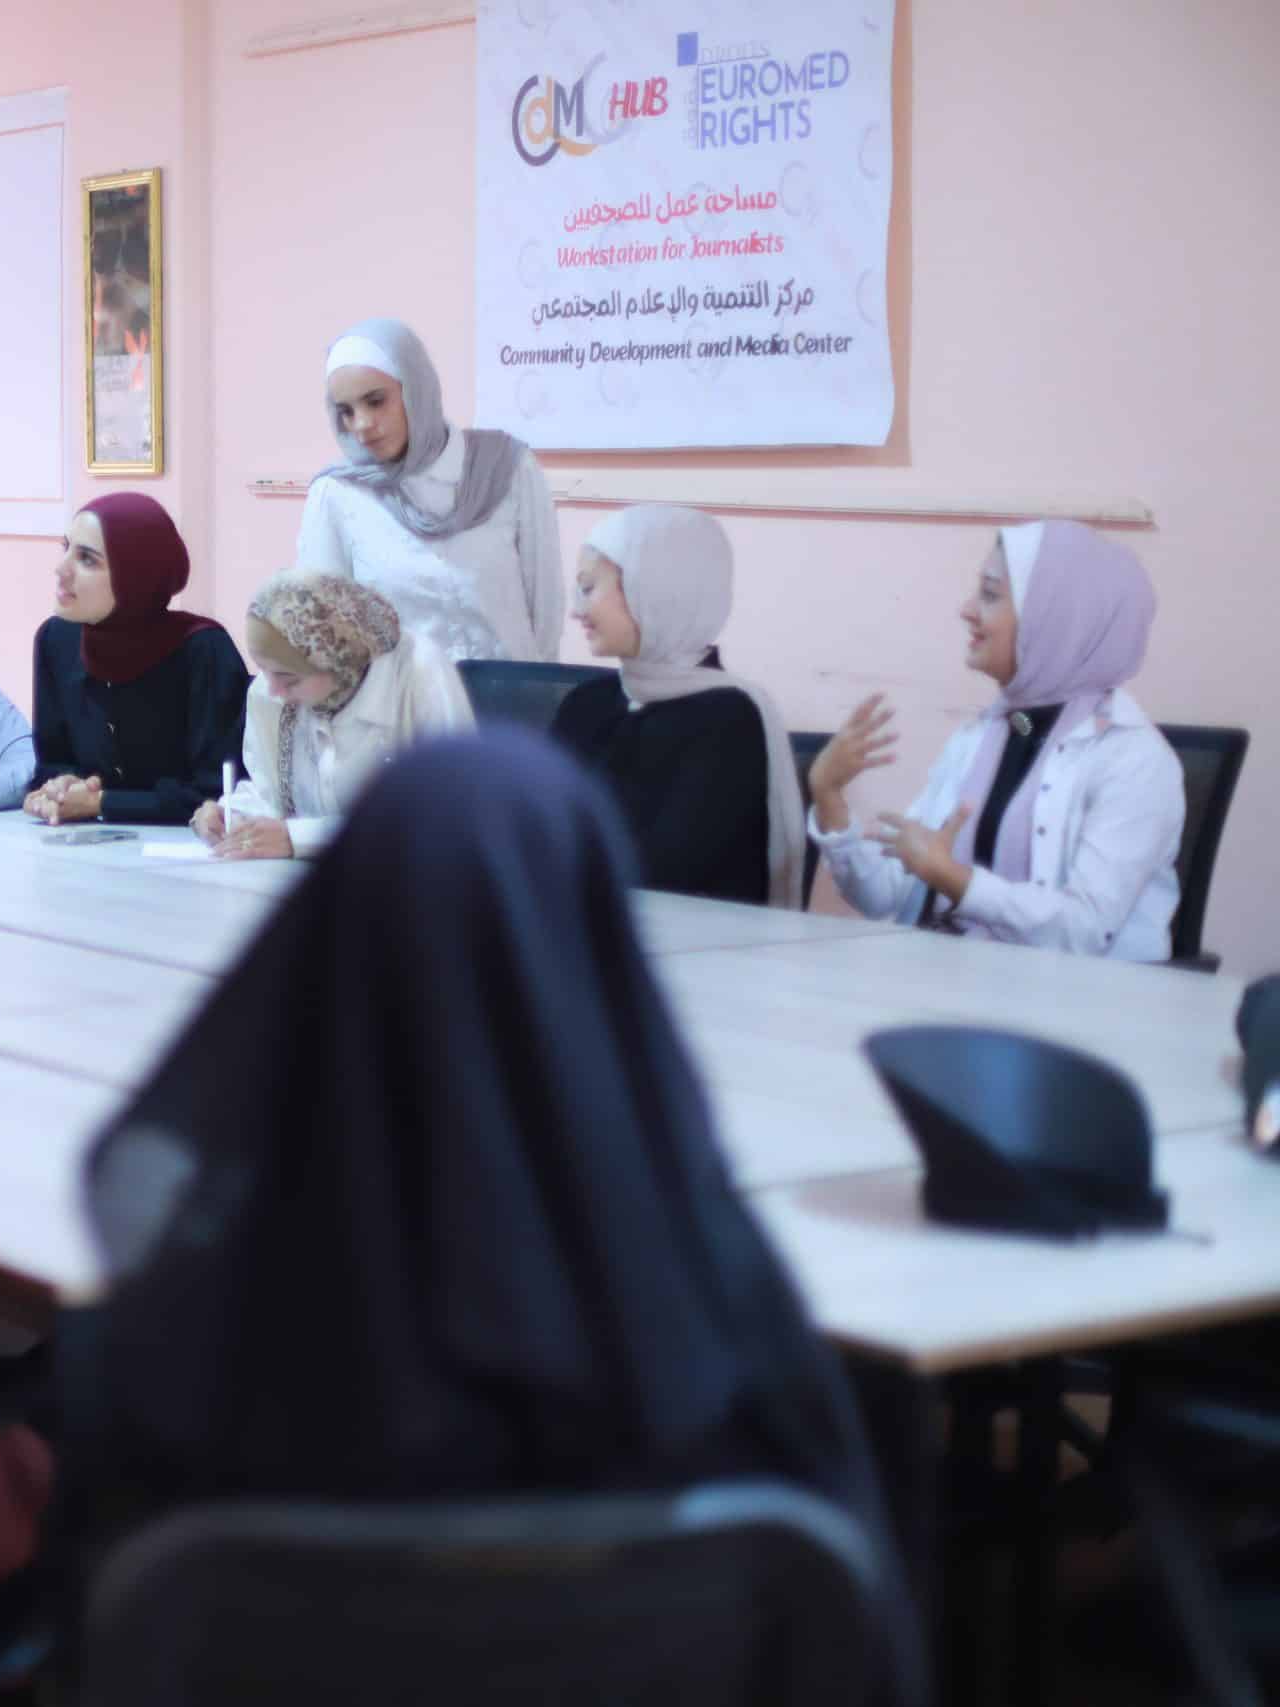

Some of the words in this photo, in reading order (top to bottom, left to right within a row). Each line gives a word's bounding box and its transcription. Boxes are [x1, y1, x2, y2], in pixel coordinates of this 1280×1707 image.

[699, 51, 851, 104] EUROMED
[608, 76, 668, 120] HUB
[699, 101, 811, 150] RIGHTS
[564, 192, 651, 232] للصحفيين
[656, 191, 698, 224] عمل
[706, 184, 777, 214] مساحة
[557, 241, 657, 269] Workstation
[662, 237, 683, 262] for
[689, 231, 785, 259] Journalists
[532, 290, 622, 331] المجتمعي
[703, 280, 770, 317] التنمية
[773, 277, 814, 317] مركز
[500, 341, 586, 370] Community
[589, 338, 691, 366] Development
[697, 335, 731, 359] and
[736, 334, 789, 357] Media
[793, 332, 853, 357] Center
